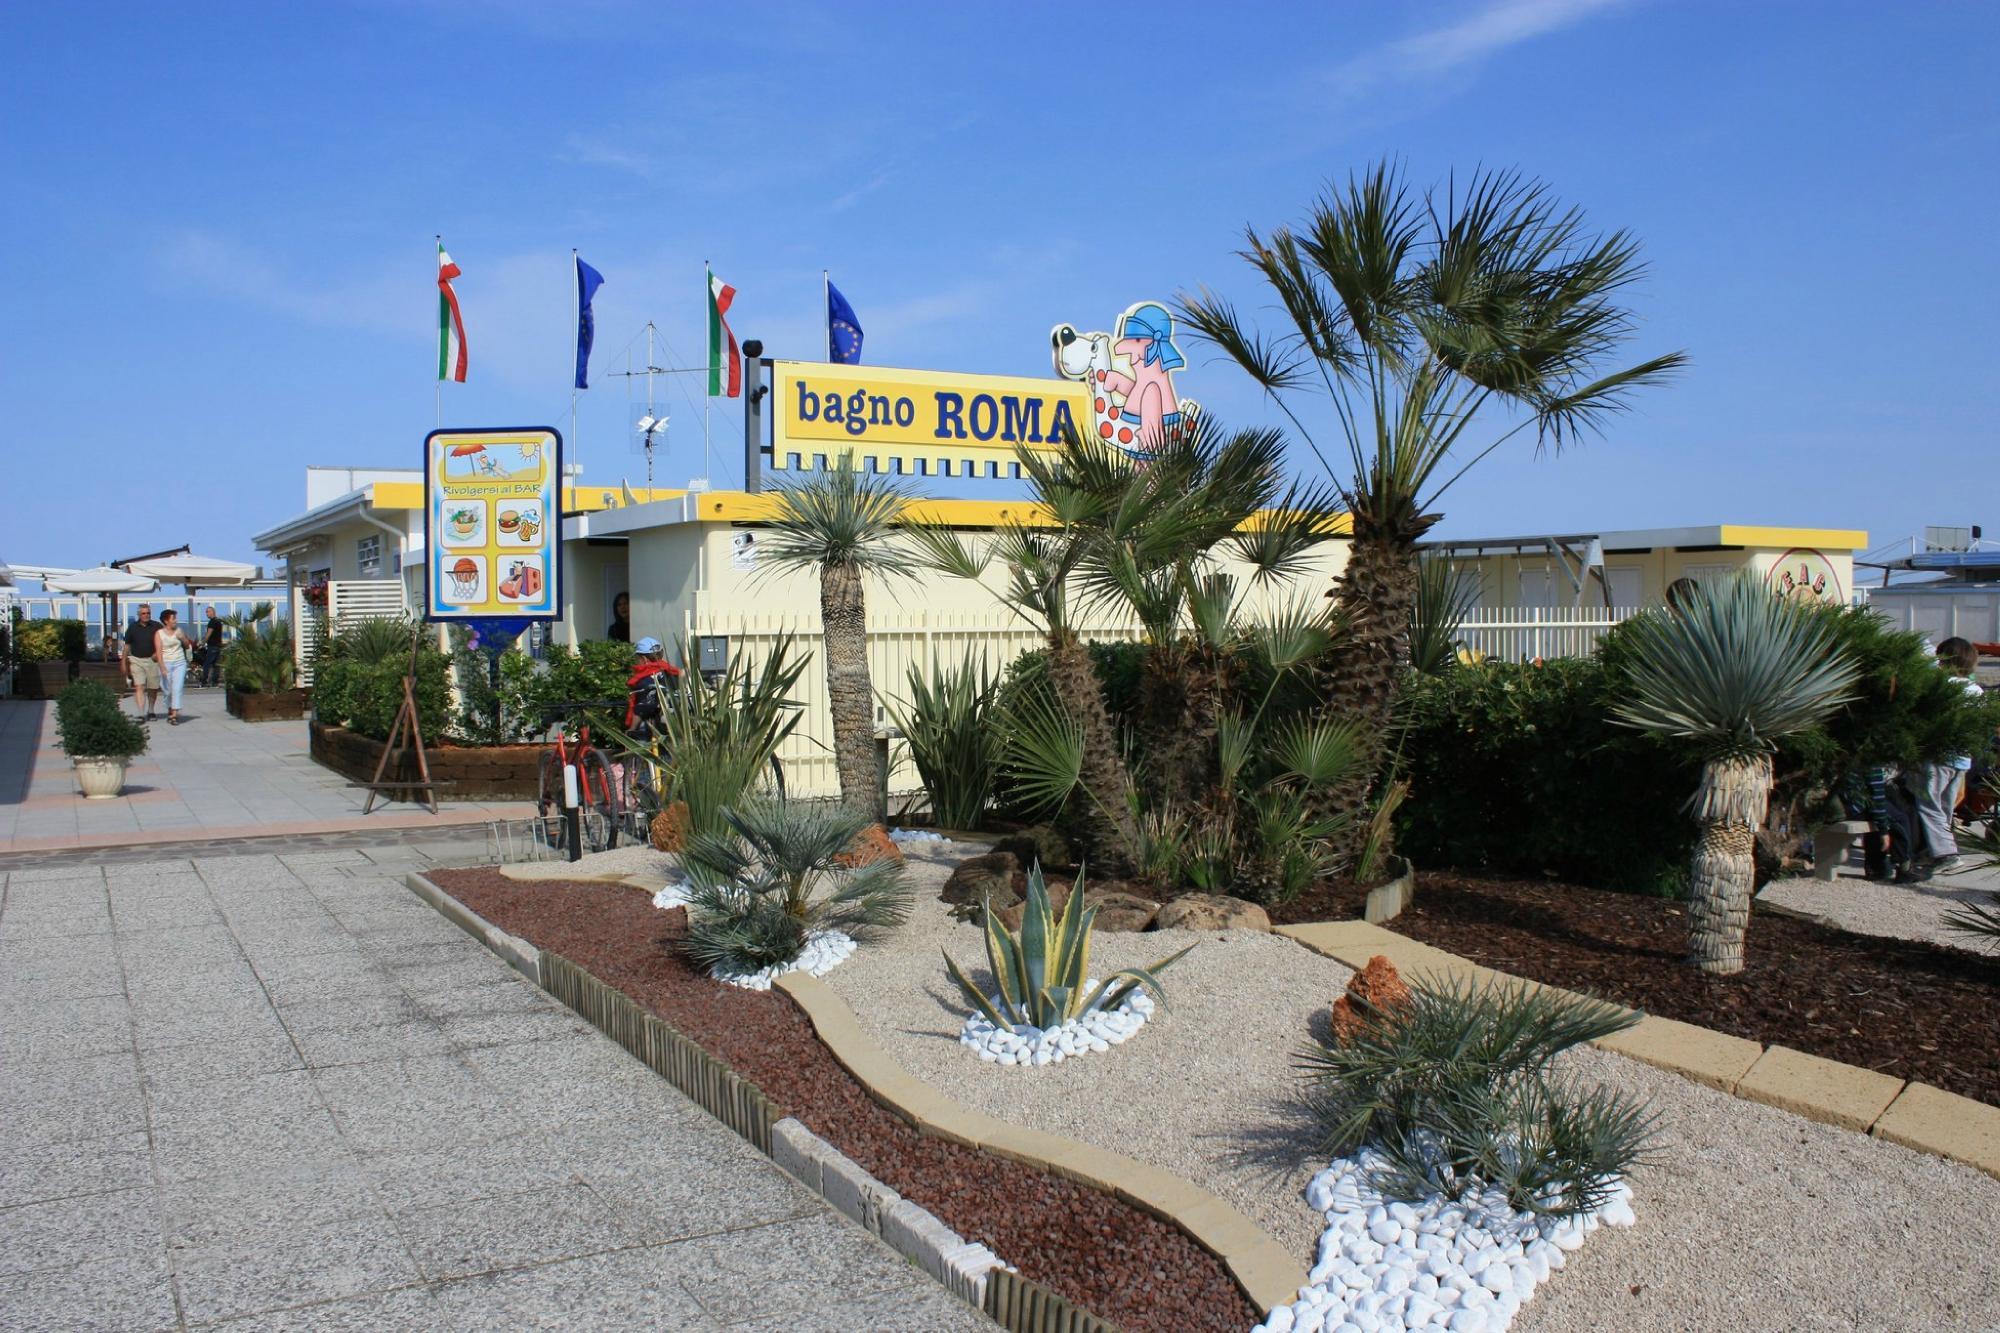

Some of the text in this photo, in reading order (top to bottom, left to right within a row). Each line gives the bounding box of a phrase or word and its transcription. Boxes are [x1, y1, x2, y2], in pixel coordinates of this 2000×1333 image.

[797, 381, 1077, 444] bagno ROMA
[443, 484, 542, 496] Rivolgersi al BAR
